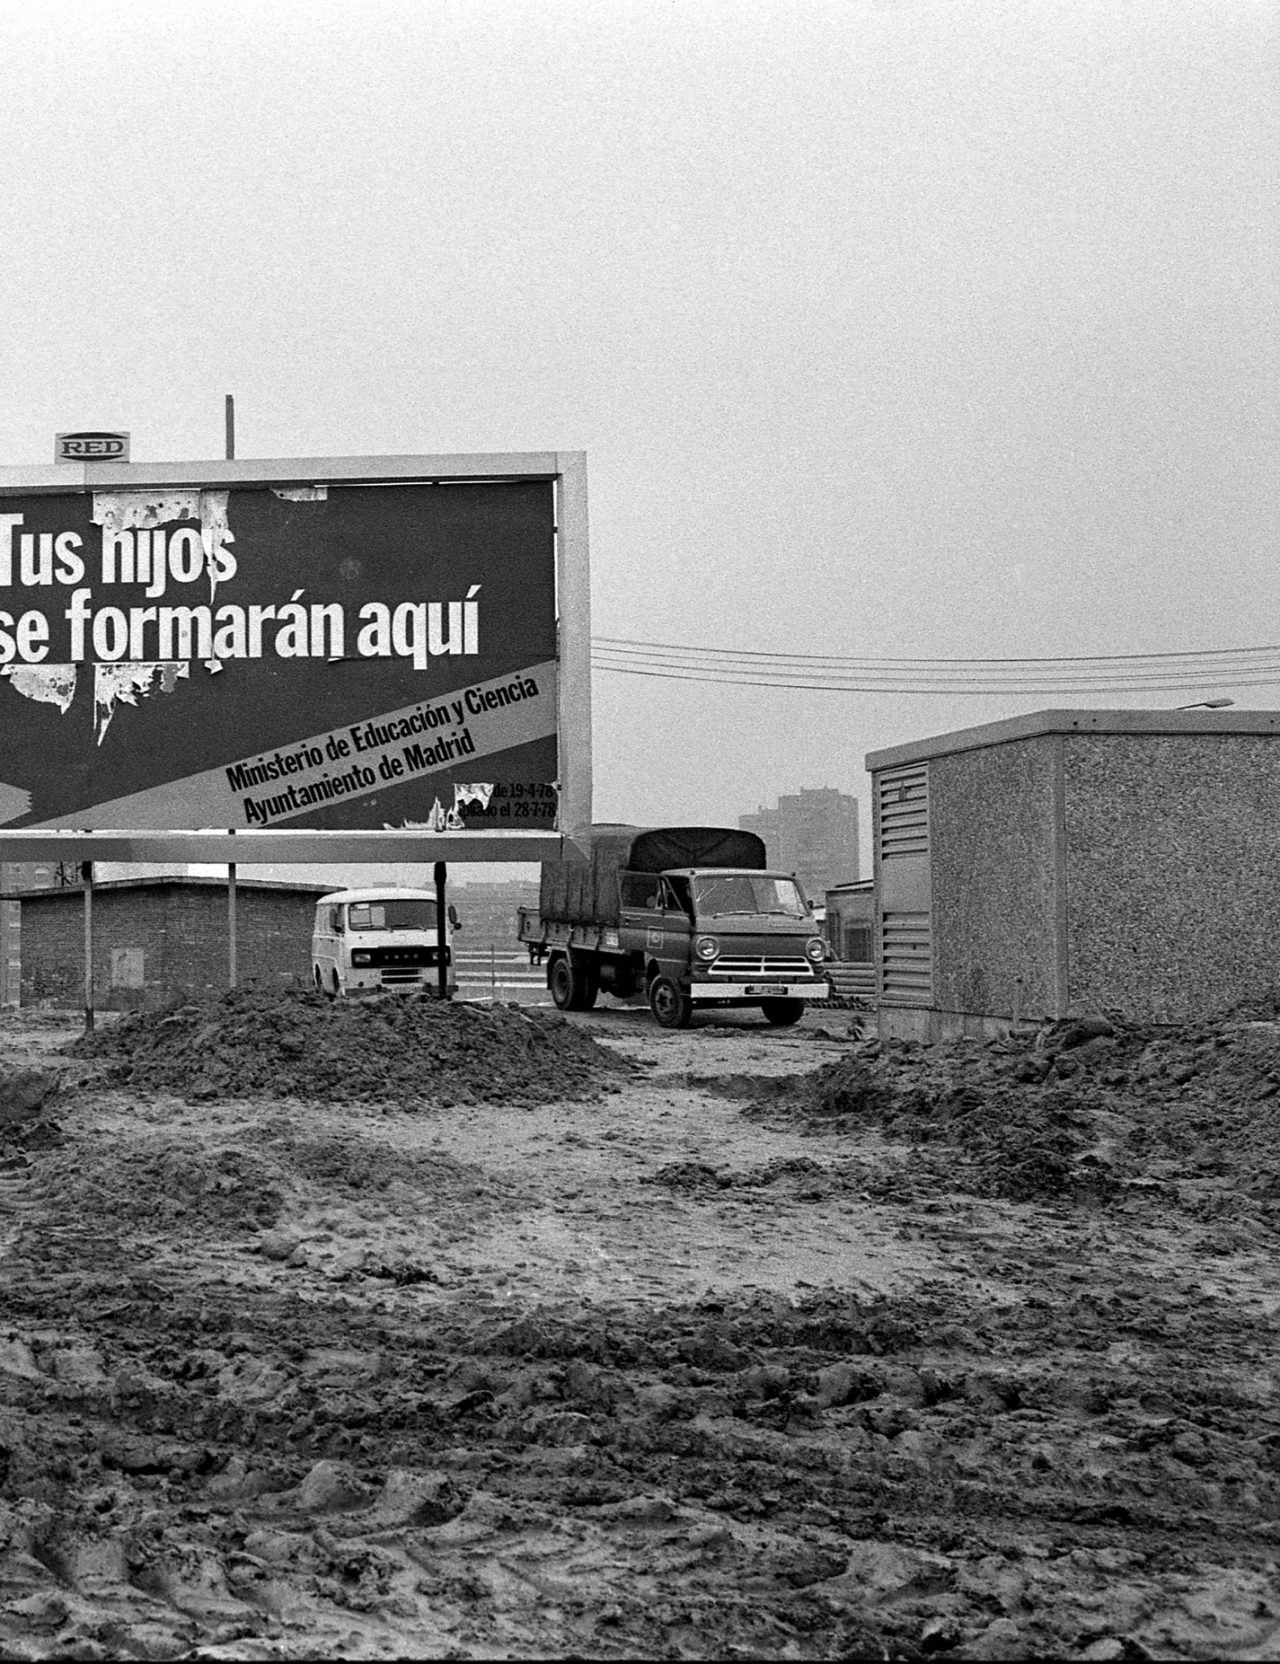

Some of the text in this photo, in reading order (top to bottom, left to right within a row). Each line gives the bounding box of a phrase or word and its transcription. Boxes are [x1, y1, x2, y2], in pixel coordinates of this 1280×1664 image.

[62, 441, 124, 454] RED
[101, 517, 237, 598] hijos
[65, 588, 345, 661] formarán
[357, 584, 482, 670] aquí
[225, 675, 539, 792] Ministerio de Educación y Ciencia
[243, 728, 476, 825] Ayuntamiento de Madrid
[500, 802, 511, 817] el
